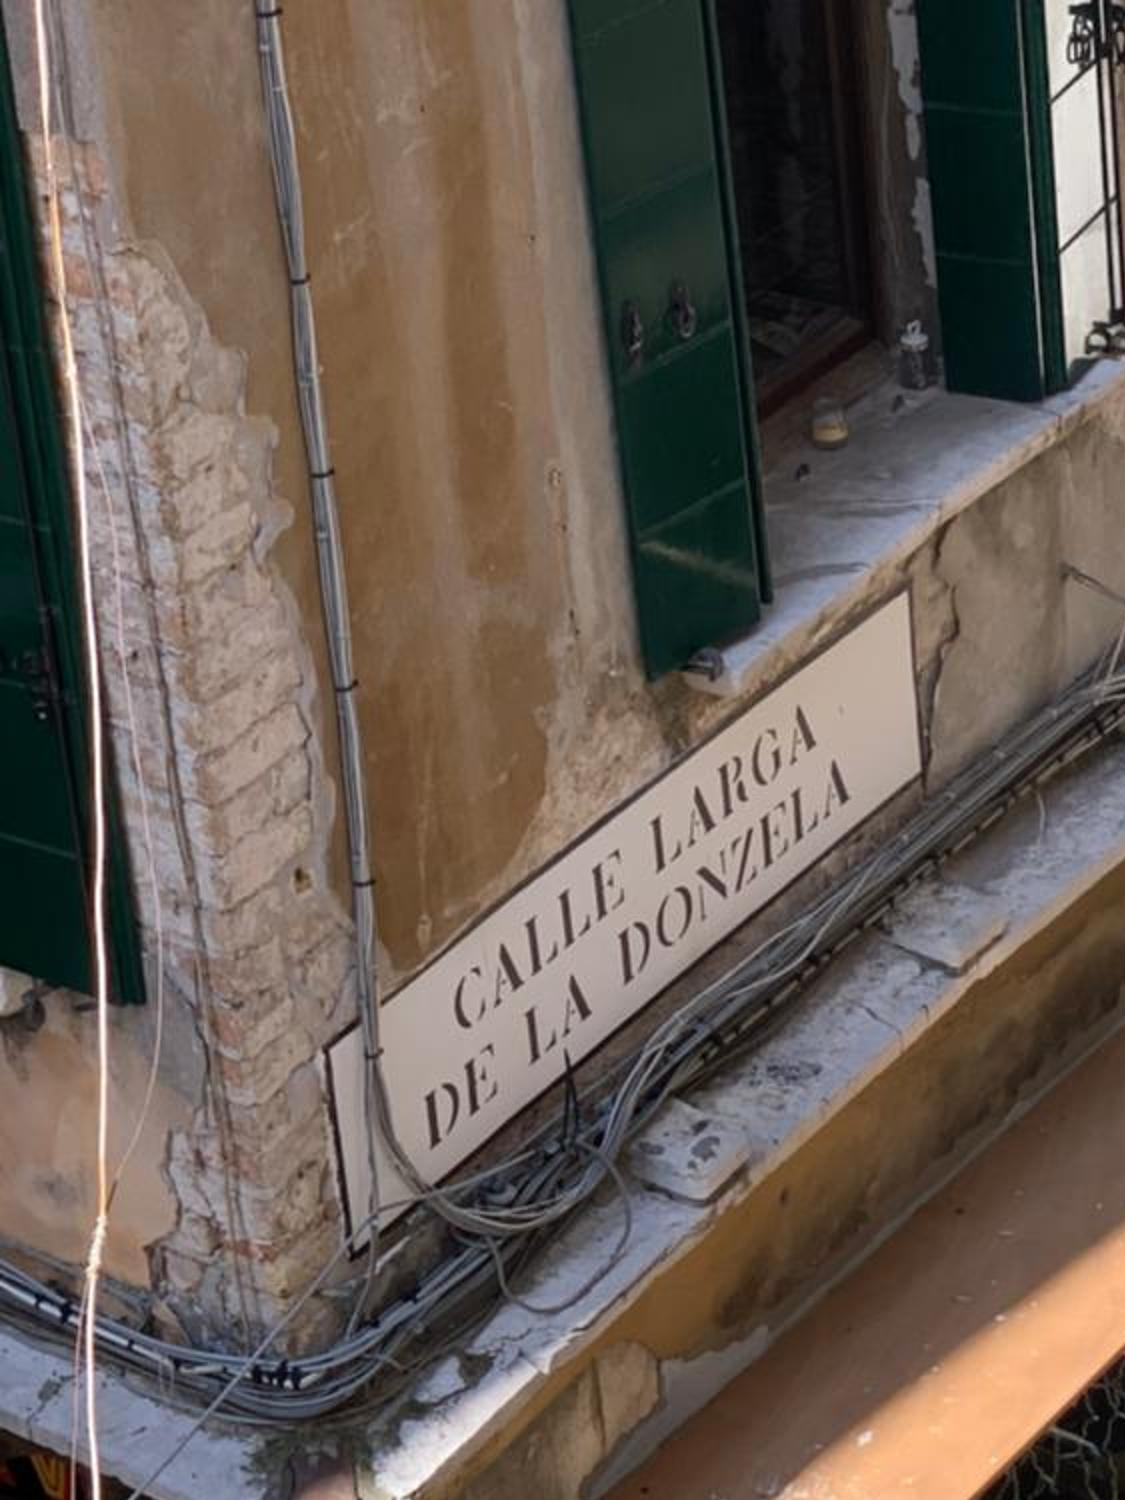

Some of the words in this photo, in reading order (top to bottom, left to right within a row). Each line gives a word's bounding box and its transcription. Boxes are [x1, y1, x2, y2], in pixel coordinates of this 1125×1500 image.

[423, 1043, 499, 1151] DE
[524, 973, 593, 1065] LA
[618, 759, 851, 985] DONZELA
[452, 849, 626, 1029] CALLE
[647, 703, 818, 873] LARGA
